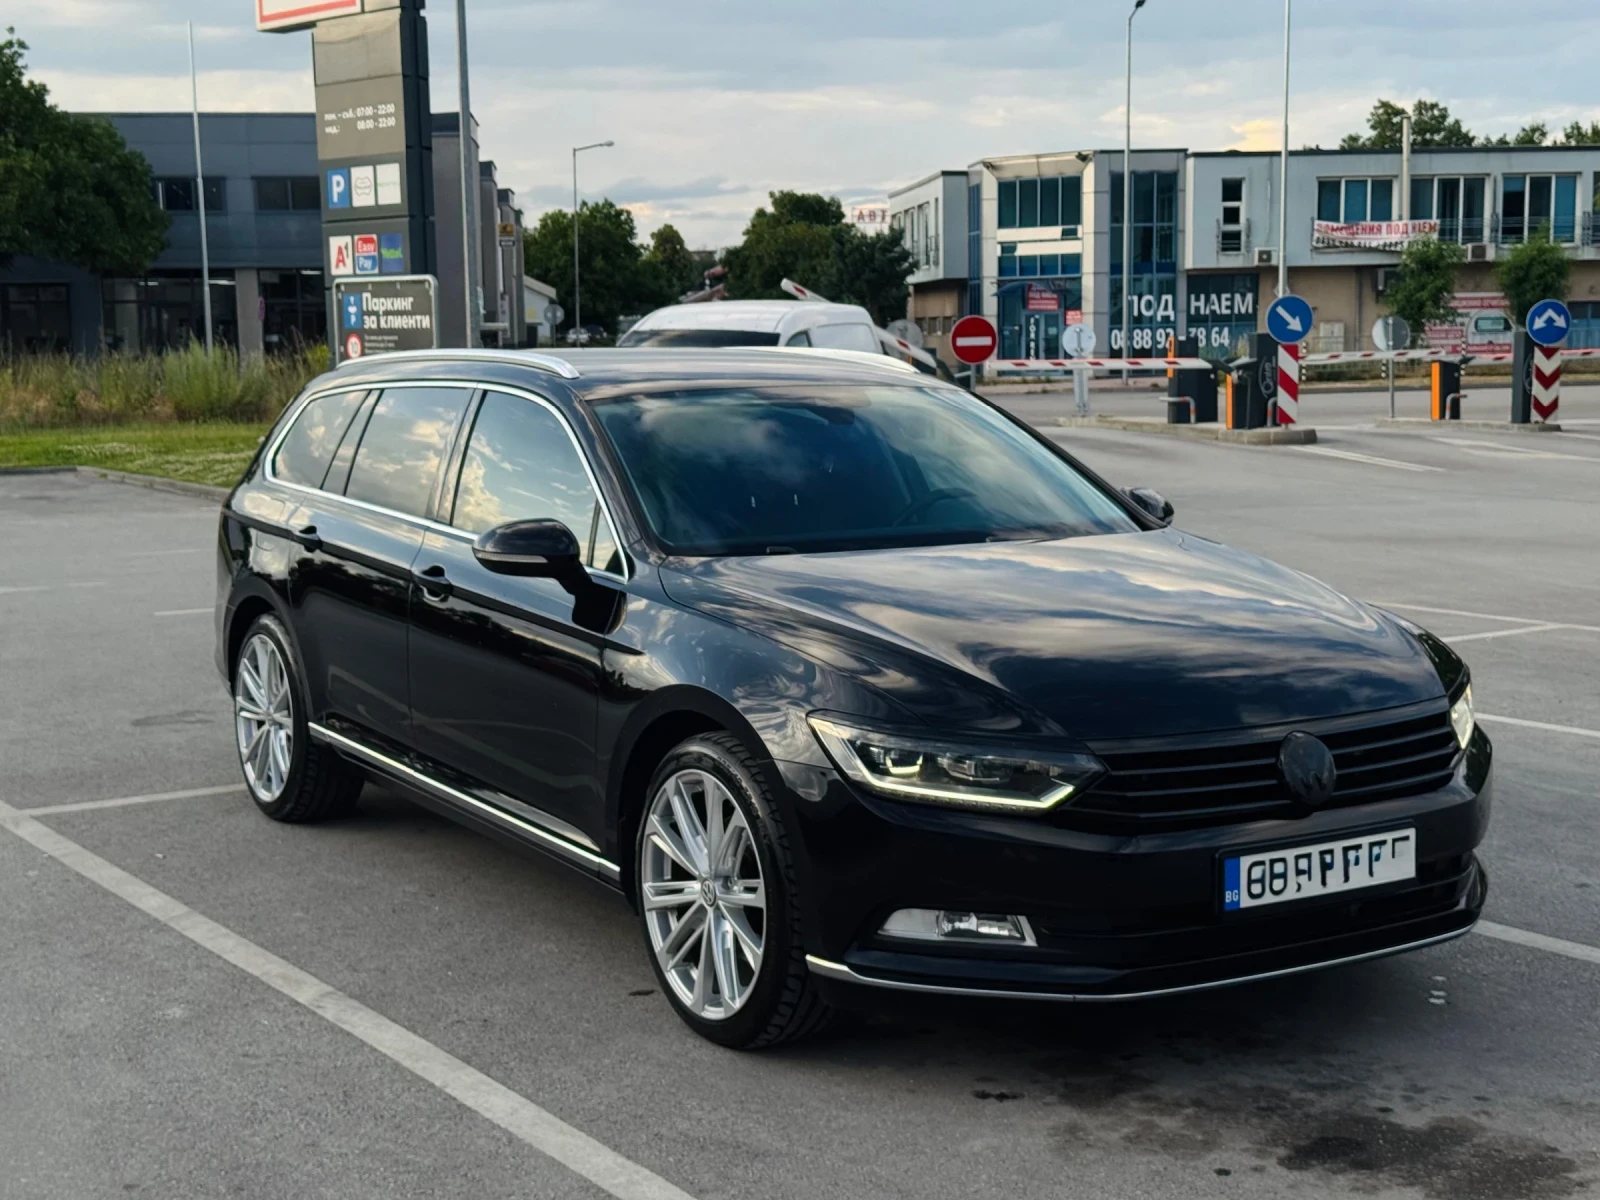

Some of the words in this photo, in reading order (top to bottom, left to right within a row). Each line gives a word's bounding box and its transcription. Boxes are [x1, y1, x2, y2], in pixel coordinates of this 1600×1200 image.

[377, 103, 395, 115] 22:00
[378, 116, 396, 128] 22:00
[331, 174, 345, 203] P
[357, 240, 375, 253] Easy
[359, 256, 373, 270] Pay
[362, 291, 414, 315] Паркинг
[1190, 292, 1253, 315] НАЕМ
[363, 315, 378, 329] за
[380, 314, 431, 329] клиенти
[1133, 328, 1152, 349] 88
[1211, 326, 1230, 347] 64
[1225, 890, 1239, 903] BG
